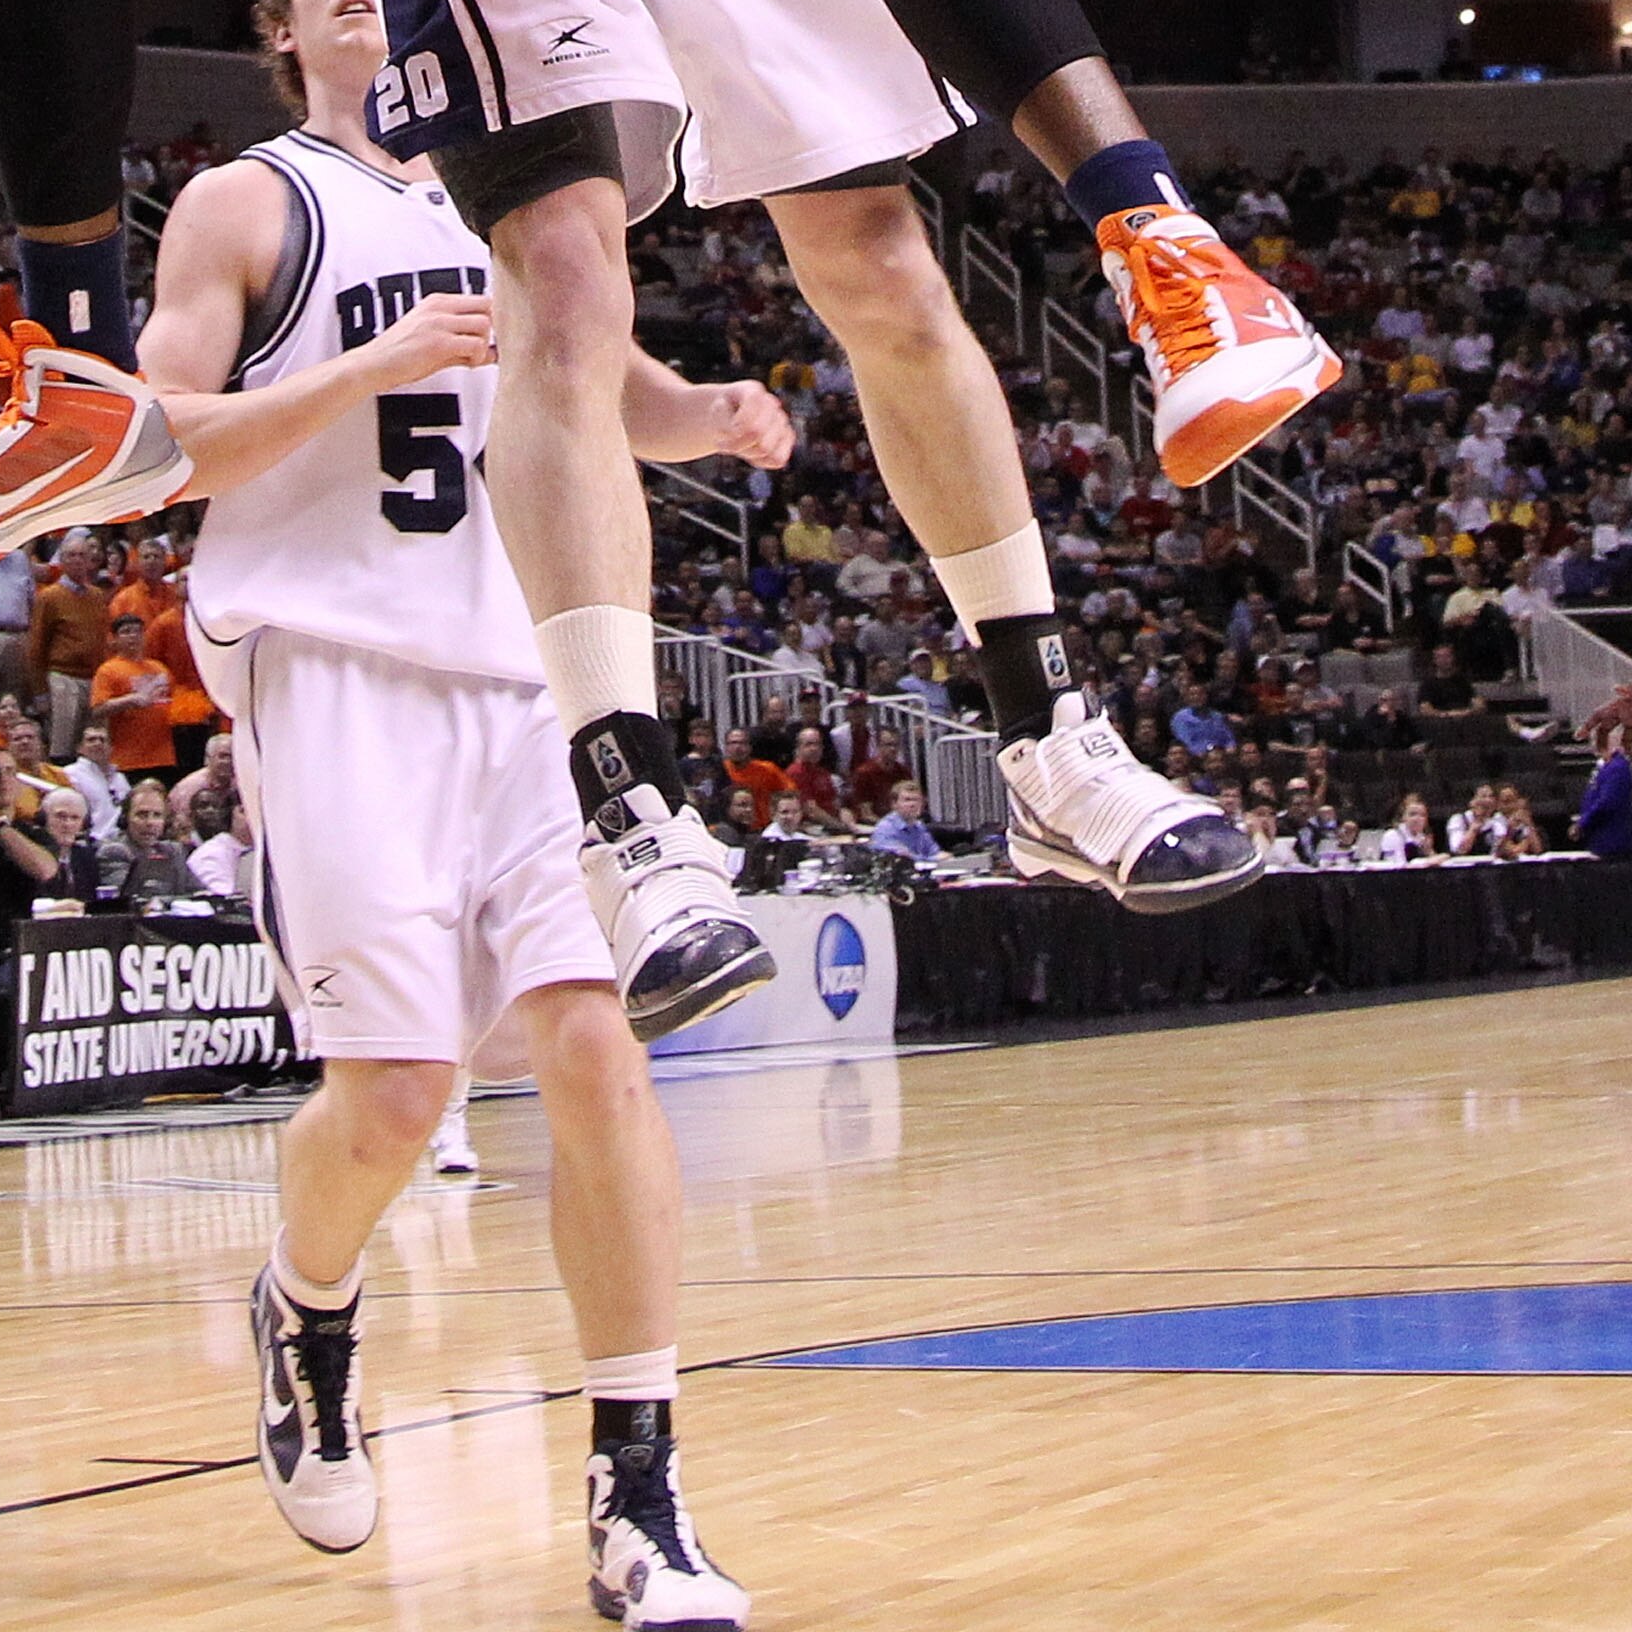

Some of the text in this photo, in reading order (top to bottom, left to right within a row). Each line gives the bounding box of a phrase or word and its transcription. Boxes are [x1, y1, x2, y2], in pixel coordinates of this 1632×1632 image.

[374, 50, 450, 135] 20
[41, 947, 114, 1023] AND
[119, 942, 276, 1015] SECOND
[23, 1026, 105, 1088] STATE
